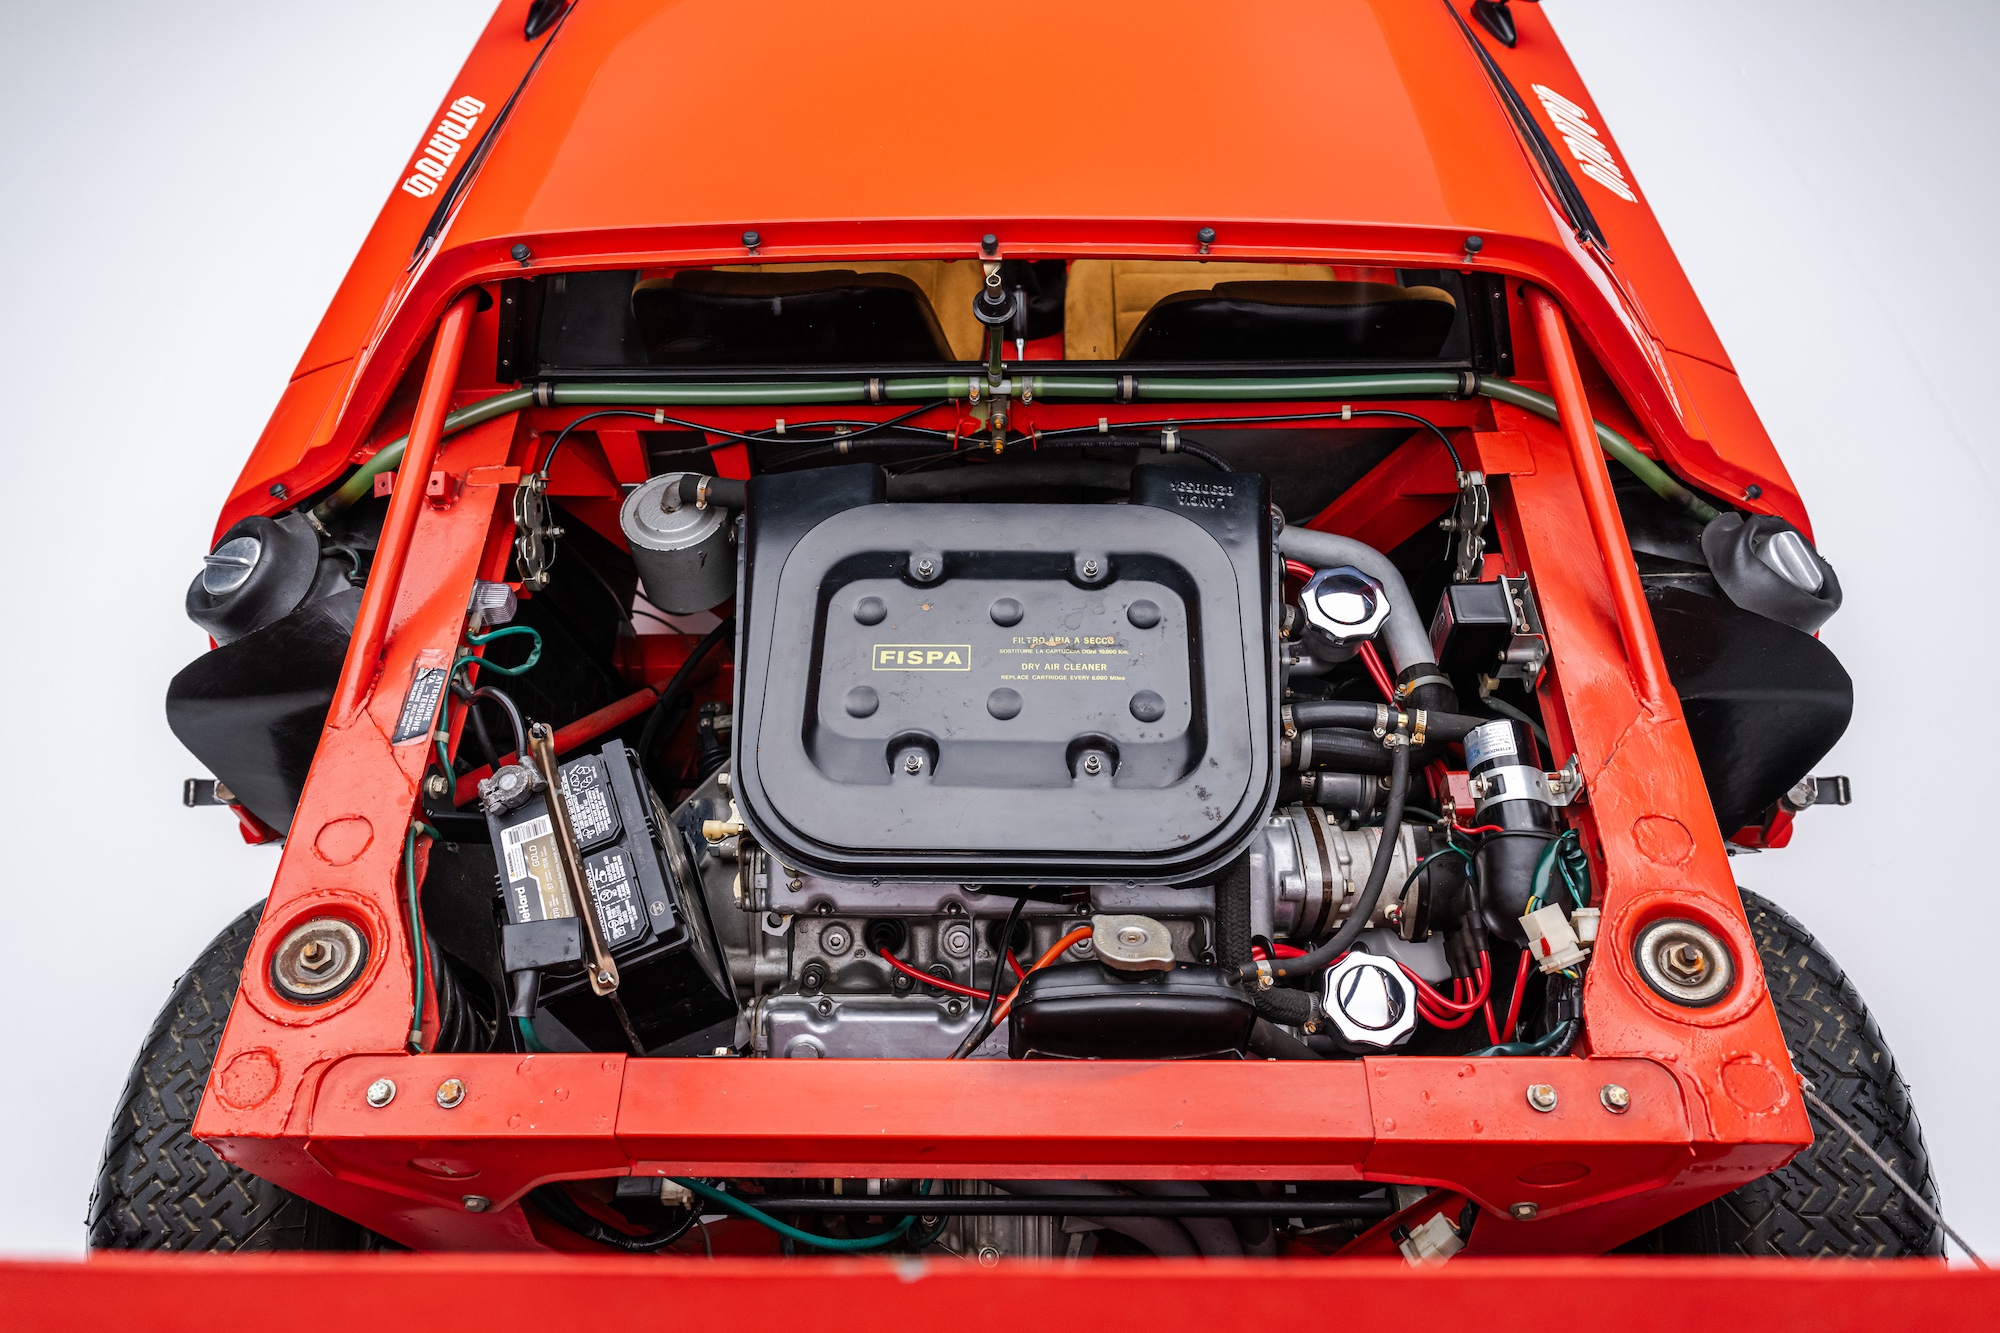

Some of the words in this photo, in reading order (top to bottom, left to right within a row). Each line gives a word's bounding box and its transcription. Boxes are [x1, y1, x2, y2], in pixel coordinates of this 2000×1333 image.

[402, 95, 486, 198] STRATOS
[1176, 494, 1226, 509] LANCIA
[1012, 636, 1045, 645] FILTRO
[1073, 637, 1081, 645] A
[1083, 636, 1115, 645] SECCO
[880, 650, 962, 665] FISPA
[1021, 662, 1041, 671] DRY
[1044, 662, 1061, 671] AIR
[1063, 662, 1108, 671] CLEANER
[422, 675, 443, 722] ATTENZIONE
[410, 692, 429, 732] TENSIONE
[528, 844, 540, 867] GOLD
[515, 886, 531, 922] ieHard
